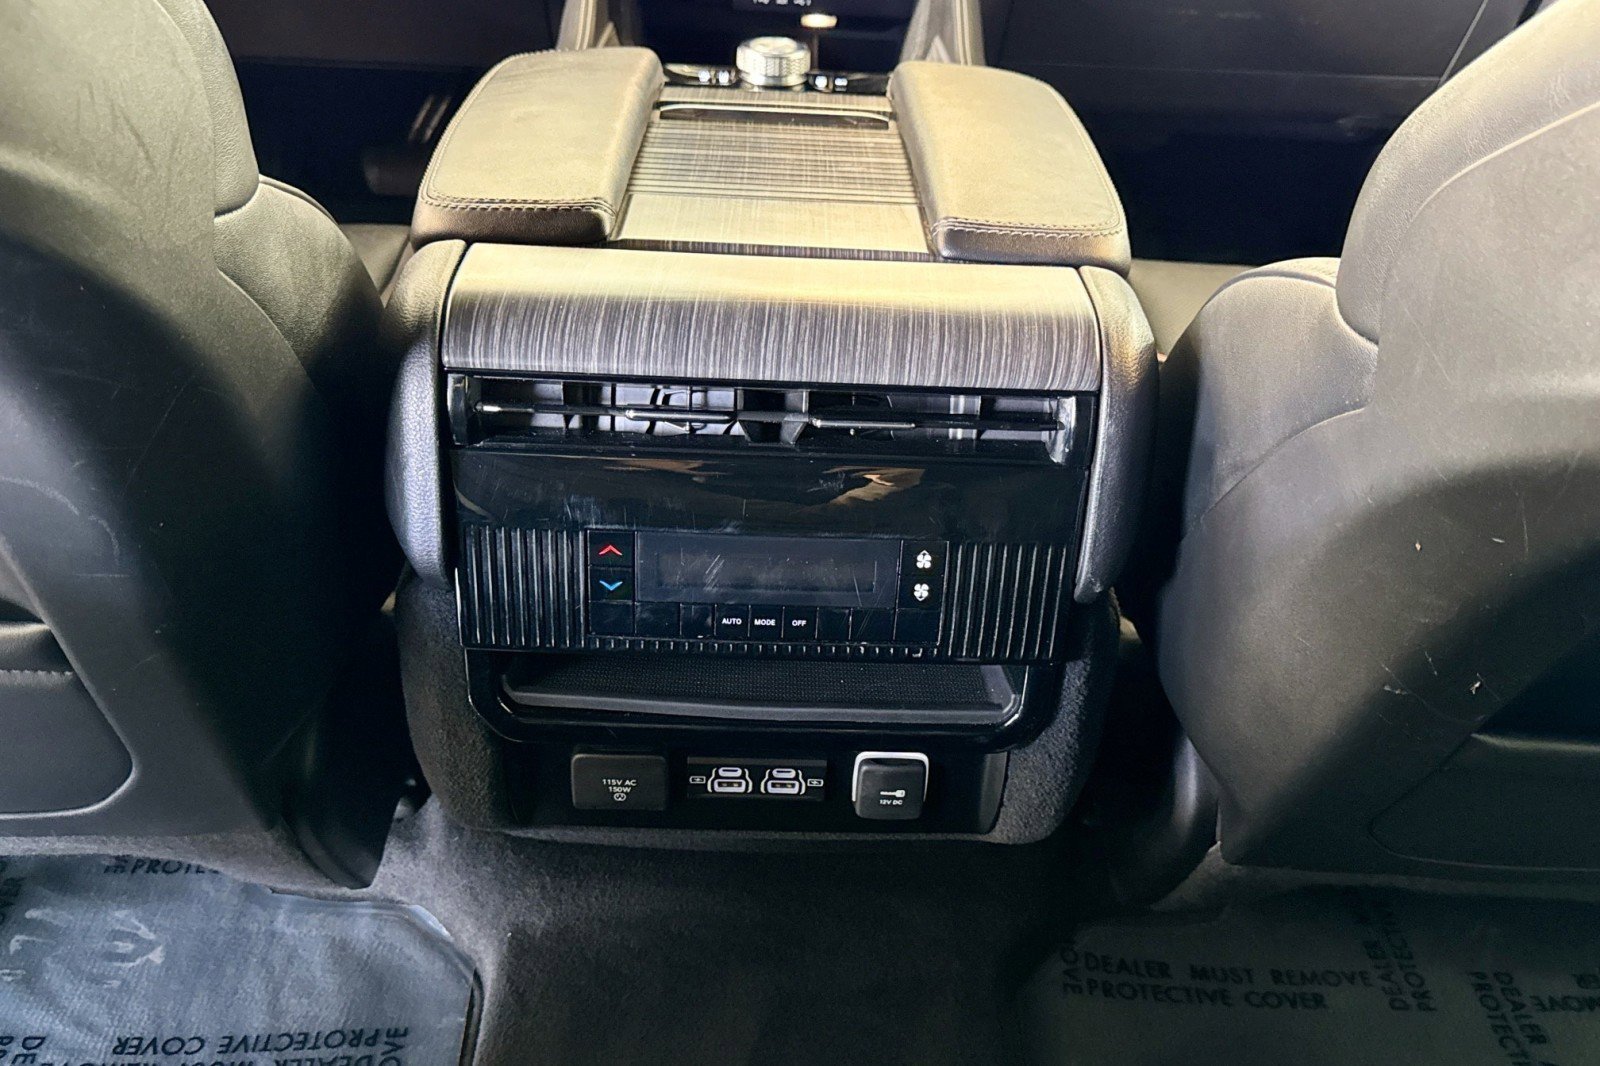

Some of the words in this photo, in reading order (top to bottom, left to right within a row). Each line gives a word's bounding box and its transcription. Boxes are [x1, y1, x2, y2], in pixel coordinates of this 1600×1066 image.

[722, 617, 742, 625] AUTO
[754, 618, 776, 626] MODE
[792, 619, 807, 627] OFF
[602, 778, 623, 786] 115V
[624, 779, 637, 787] AC
[1083, 951, 1173, 980] DEALER
[1189, 964, 1253, 985] MUST
[1269, 968, 1374, 988] REMOVE
[1085, 978, 1233, 1007] PROTECTIVE
[1243, 991, 1327, 1010] COVER
[1493, 971, 1548, 1045] DEALER
[112, 1036, 206, 1056] COVER
[217, 1027, 381, 1055] PROTECTIVE
